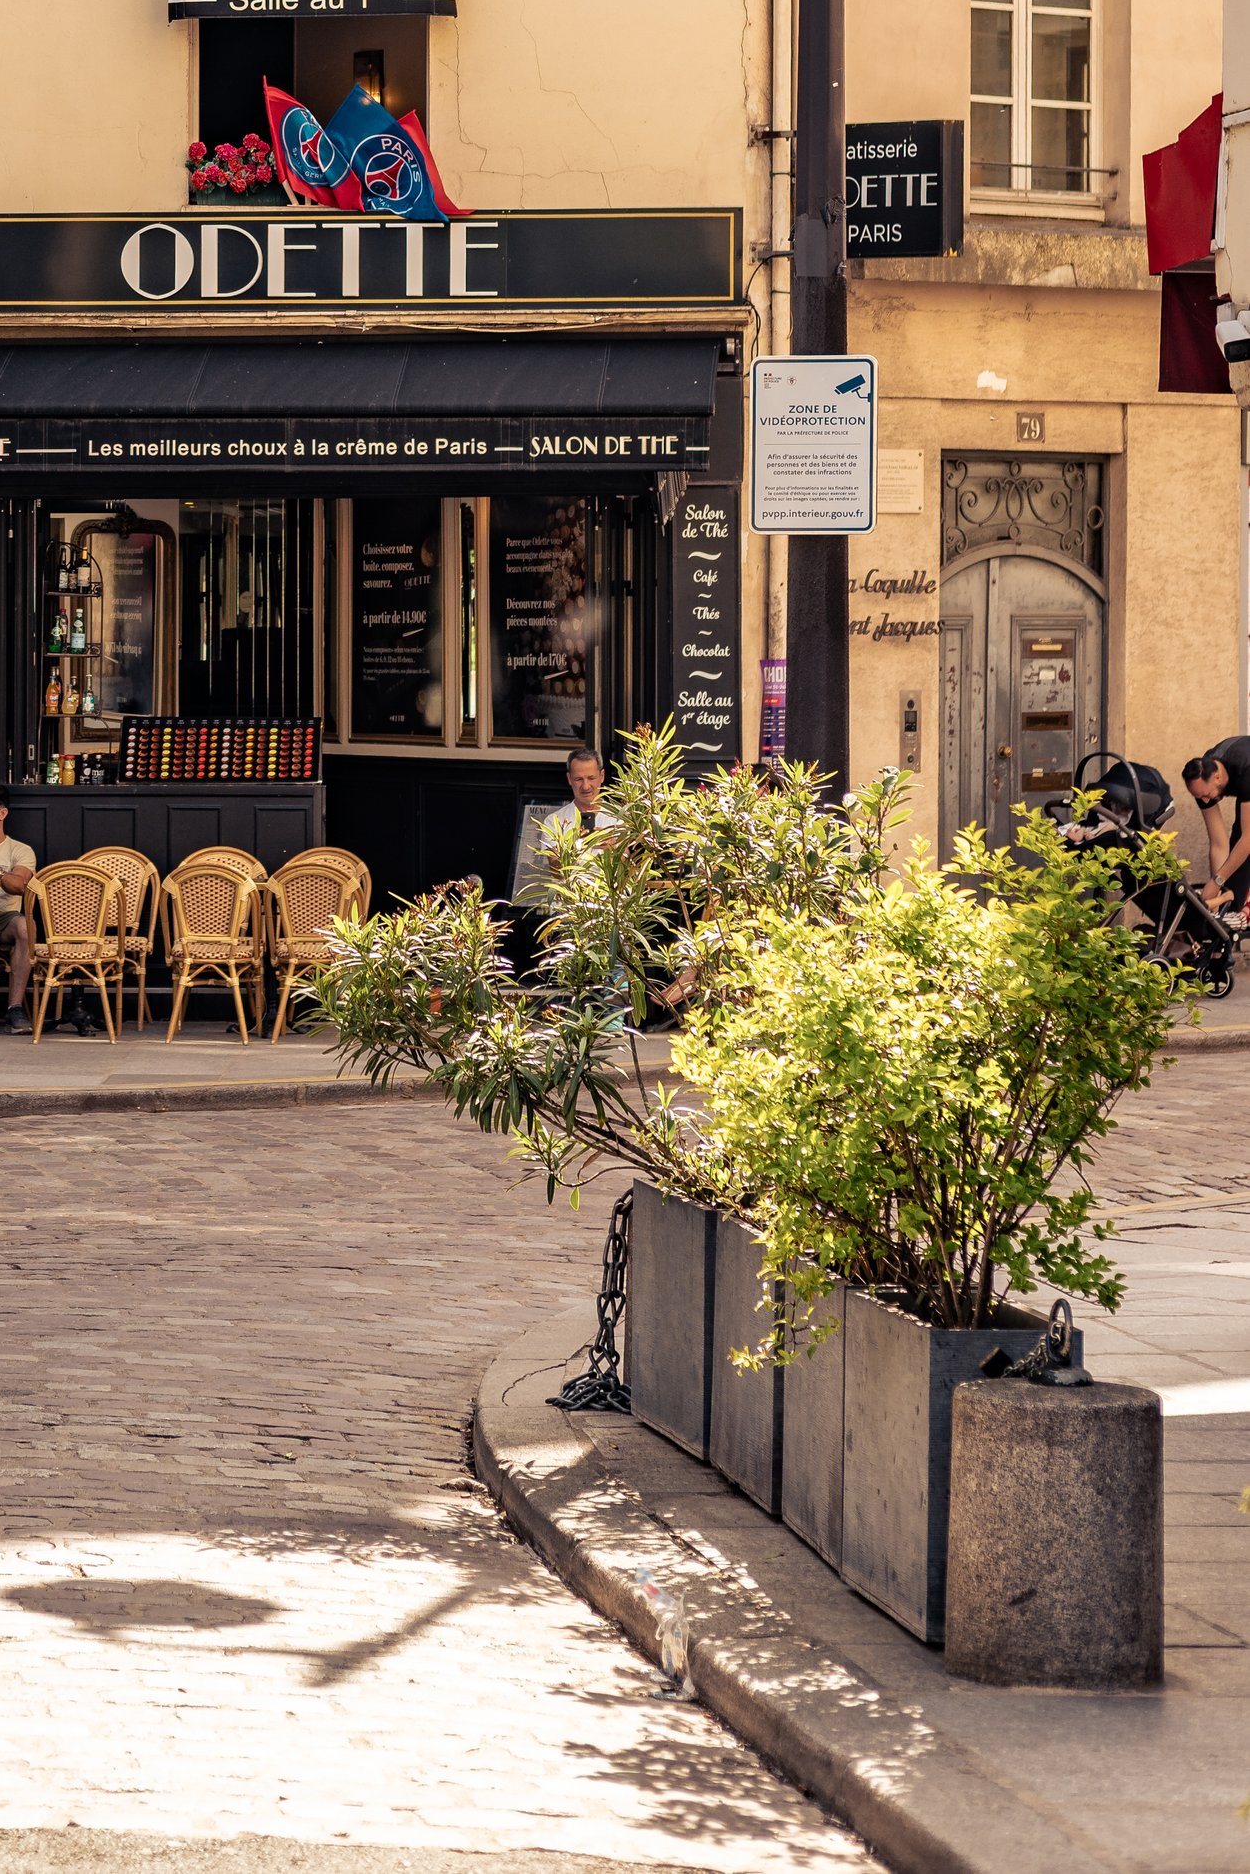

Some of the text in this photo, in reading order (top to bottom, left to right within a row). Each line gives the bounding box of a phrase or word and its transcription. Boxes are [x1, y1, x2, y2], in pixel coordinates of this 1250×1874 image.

[846, 138, 918, 160] atisserie
[381, 138, 421, 183] PARIS
[845, 173, 938, 209] DETTE
[848, 223, 903, 243] PARIS
[120, 222, 499, 300] ODETTE
[788, 405, 838, 414] ZONE DE
[760, 415, 866, 426] VIDÉOPROTECTION
[1021, 417, 1040, 440] 79
[88, 437, 488, 456] Les meilleurs choux à la crême de Paris
[529, 435, 679, 458] SALON DE THE
[685, 504, 726, 520] Salon
[762, 509, 864, 520] pvpp.interieur.gouv.fr
[682, 522, 729, 538] de Thé
[363, 543, 413, 555] Choisissez votre
[693, 569, 718, 586] Café
[860, 568, 937, 600] Coquille
[506, 598, 556, 610] Découvrez nos
[363, 611, 368, 624] à
[369, 610, 391, 627] partir
[391, 610, 401, 624] de
[692, 606, 720, 620] Thés
[506, 615, 558, 630] pièces montées
[872, 612, 945, 642] Jacques
[682, 643, 730, 657] Chocolat
[507, 653, 512, 666] à
[513, 653, 537, 670] partir
[537, 652, 548, 666] de
[764, 666, 786, 683] CHO
[677, 690, 734, 707] Salle au
[681, 710, 731, 730] 1er étage
